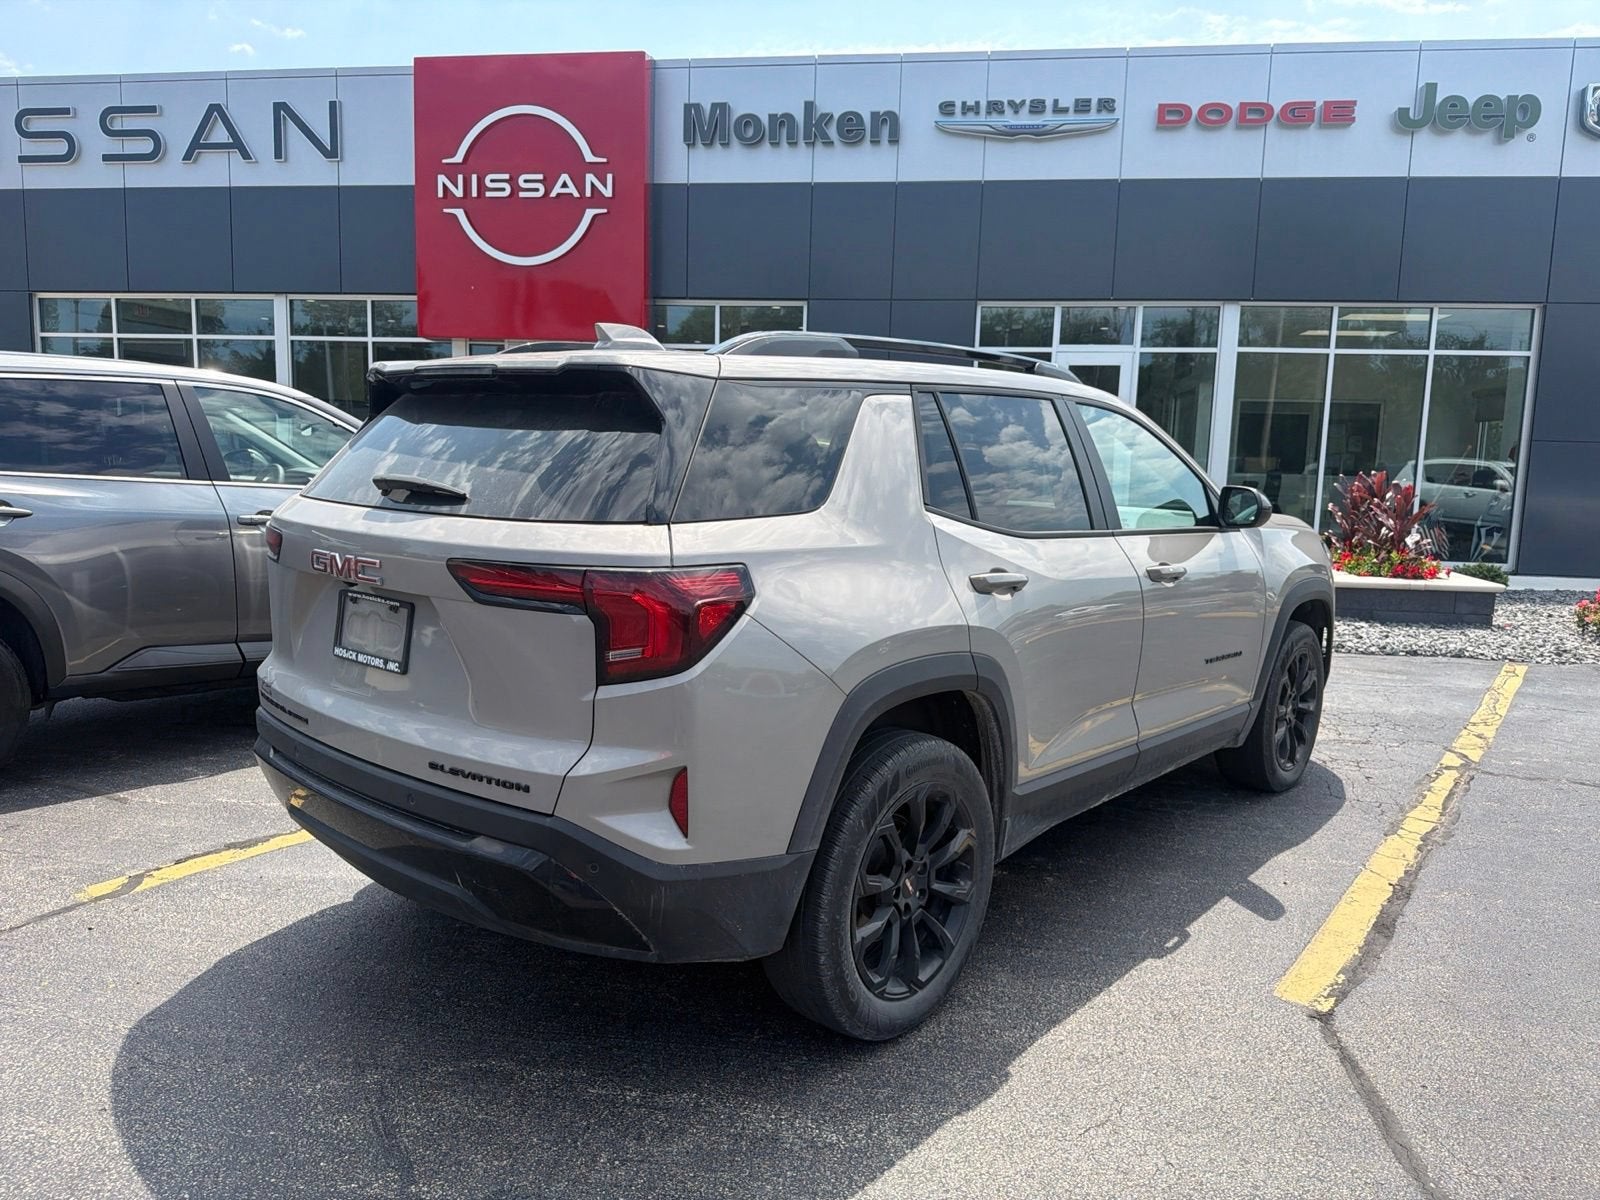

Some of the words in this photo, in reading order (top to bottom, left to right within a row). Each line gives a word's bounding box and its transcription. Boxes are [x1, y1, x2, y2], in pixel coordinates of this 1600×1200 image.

[937, 97, 1117, 115] CHRYSLER
[1156, 99, 1357, 128] DODGE
[1396, 82, 1542, 140] Jeep
[683, 101, 900, 147] Monken
[436, 172, 613, 199] NISSAN
[311, 548, 383, 585] GMC
[428, 761, 531, 794] ELEVATION
